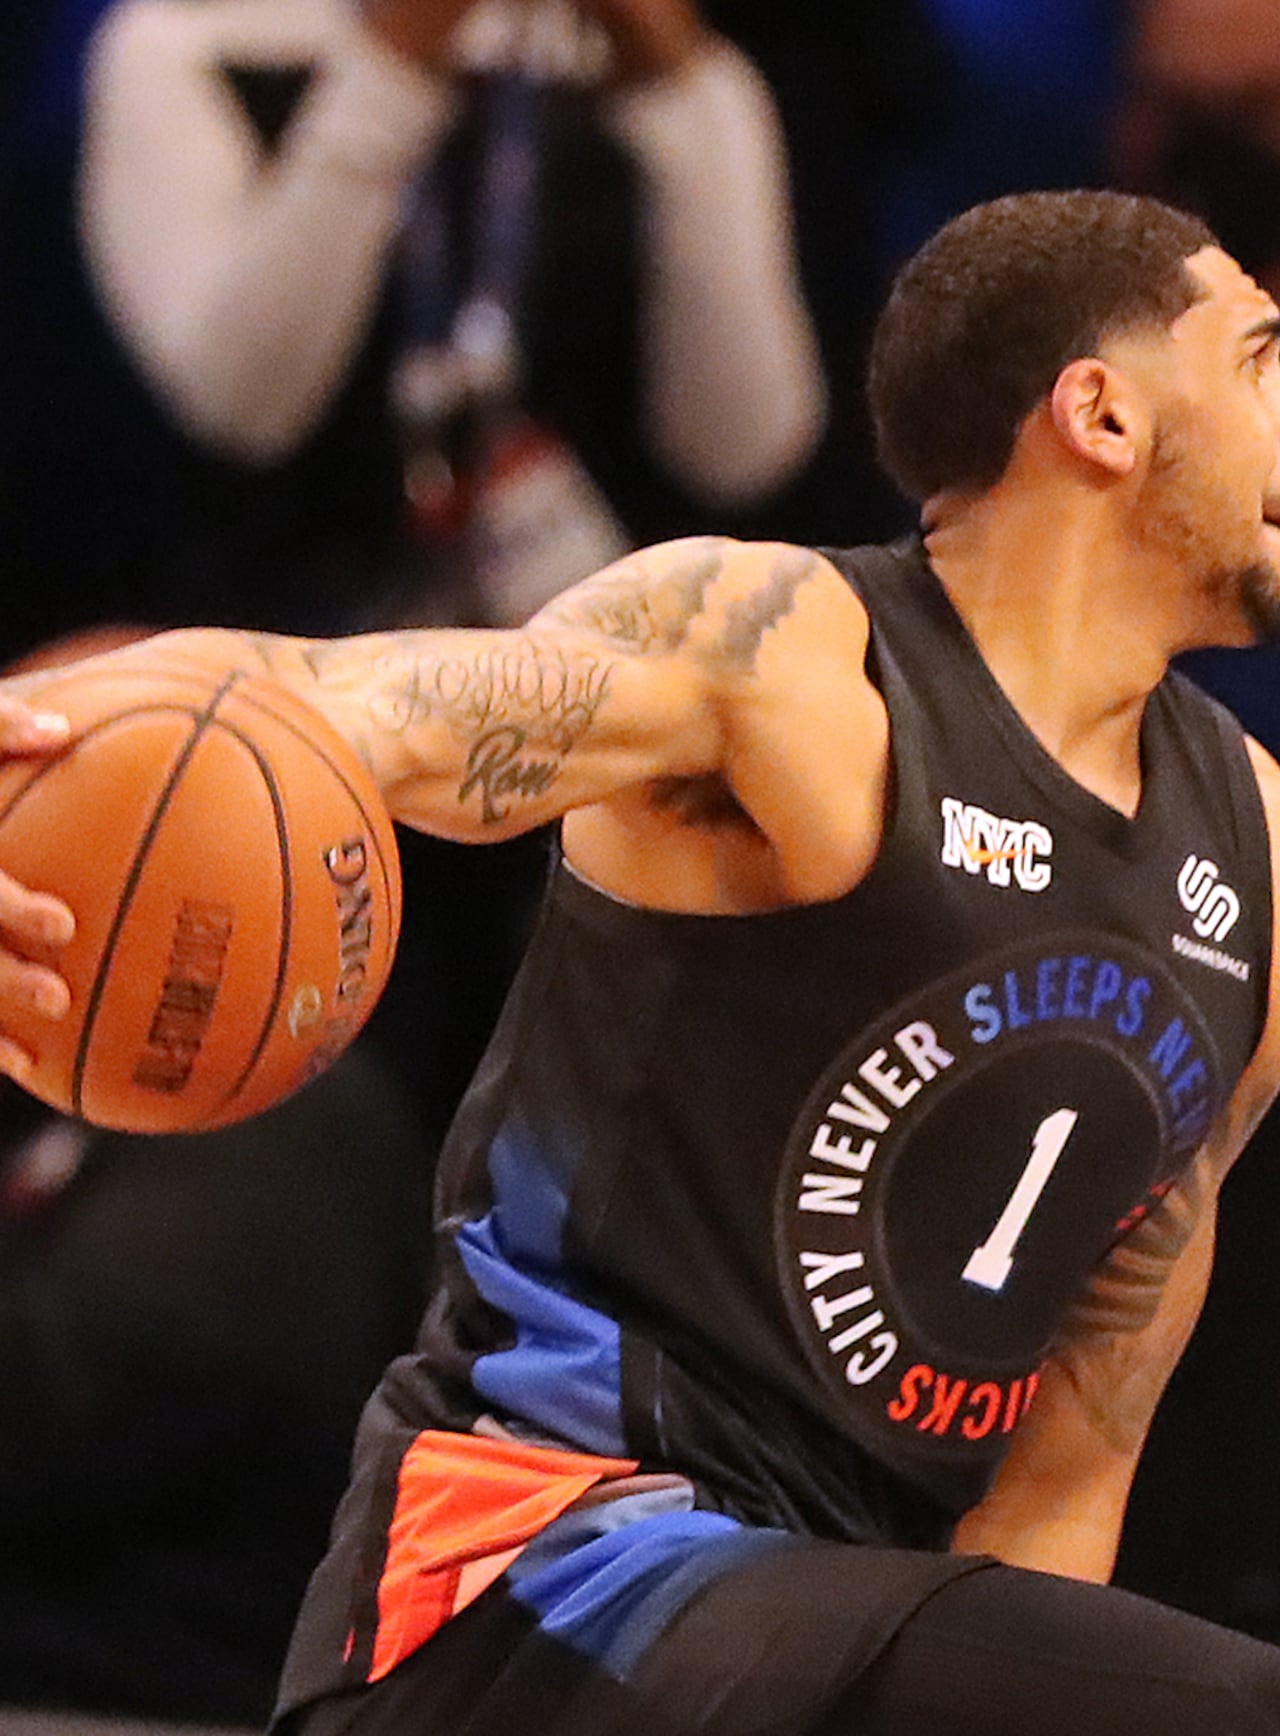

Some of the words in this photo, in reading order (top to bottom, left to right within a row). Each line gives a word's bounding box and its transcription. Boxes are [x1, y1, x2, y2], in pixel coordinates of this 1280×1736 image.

[941, 797, 1053, 892] NYC
[964, 955, 1151, 1044] SLEEPS
[798, 1020, 955, 1216] NEVER
[961, 1108, 1078, 1291] 1
[798, 1250, 899, 1386] CITY
[887, 1363, 1041, 1441] ICKS
